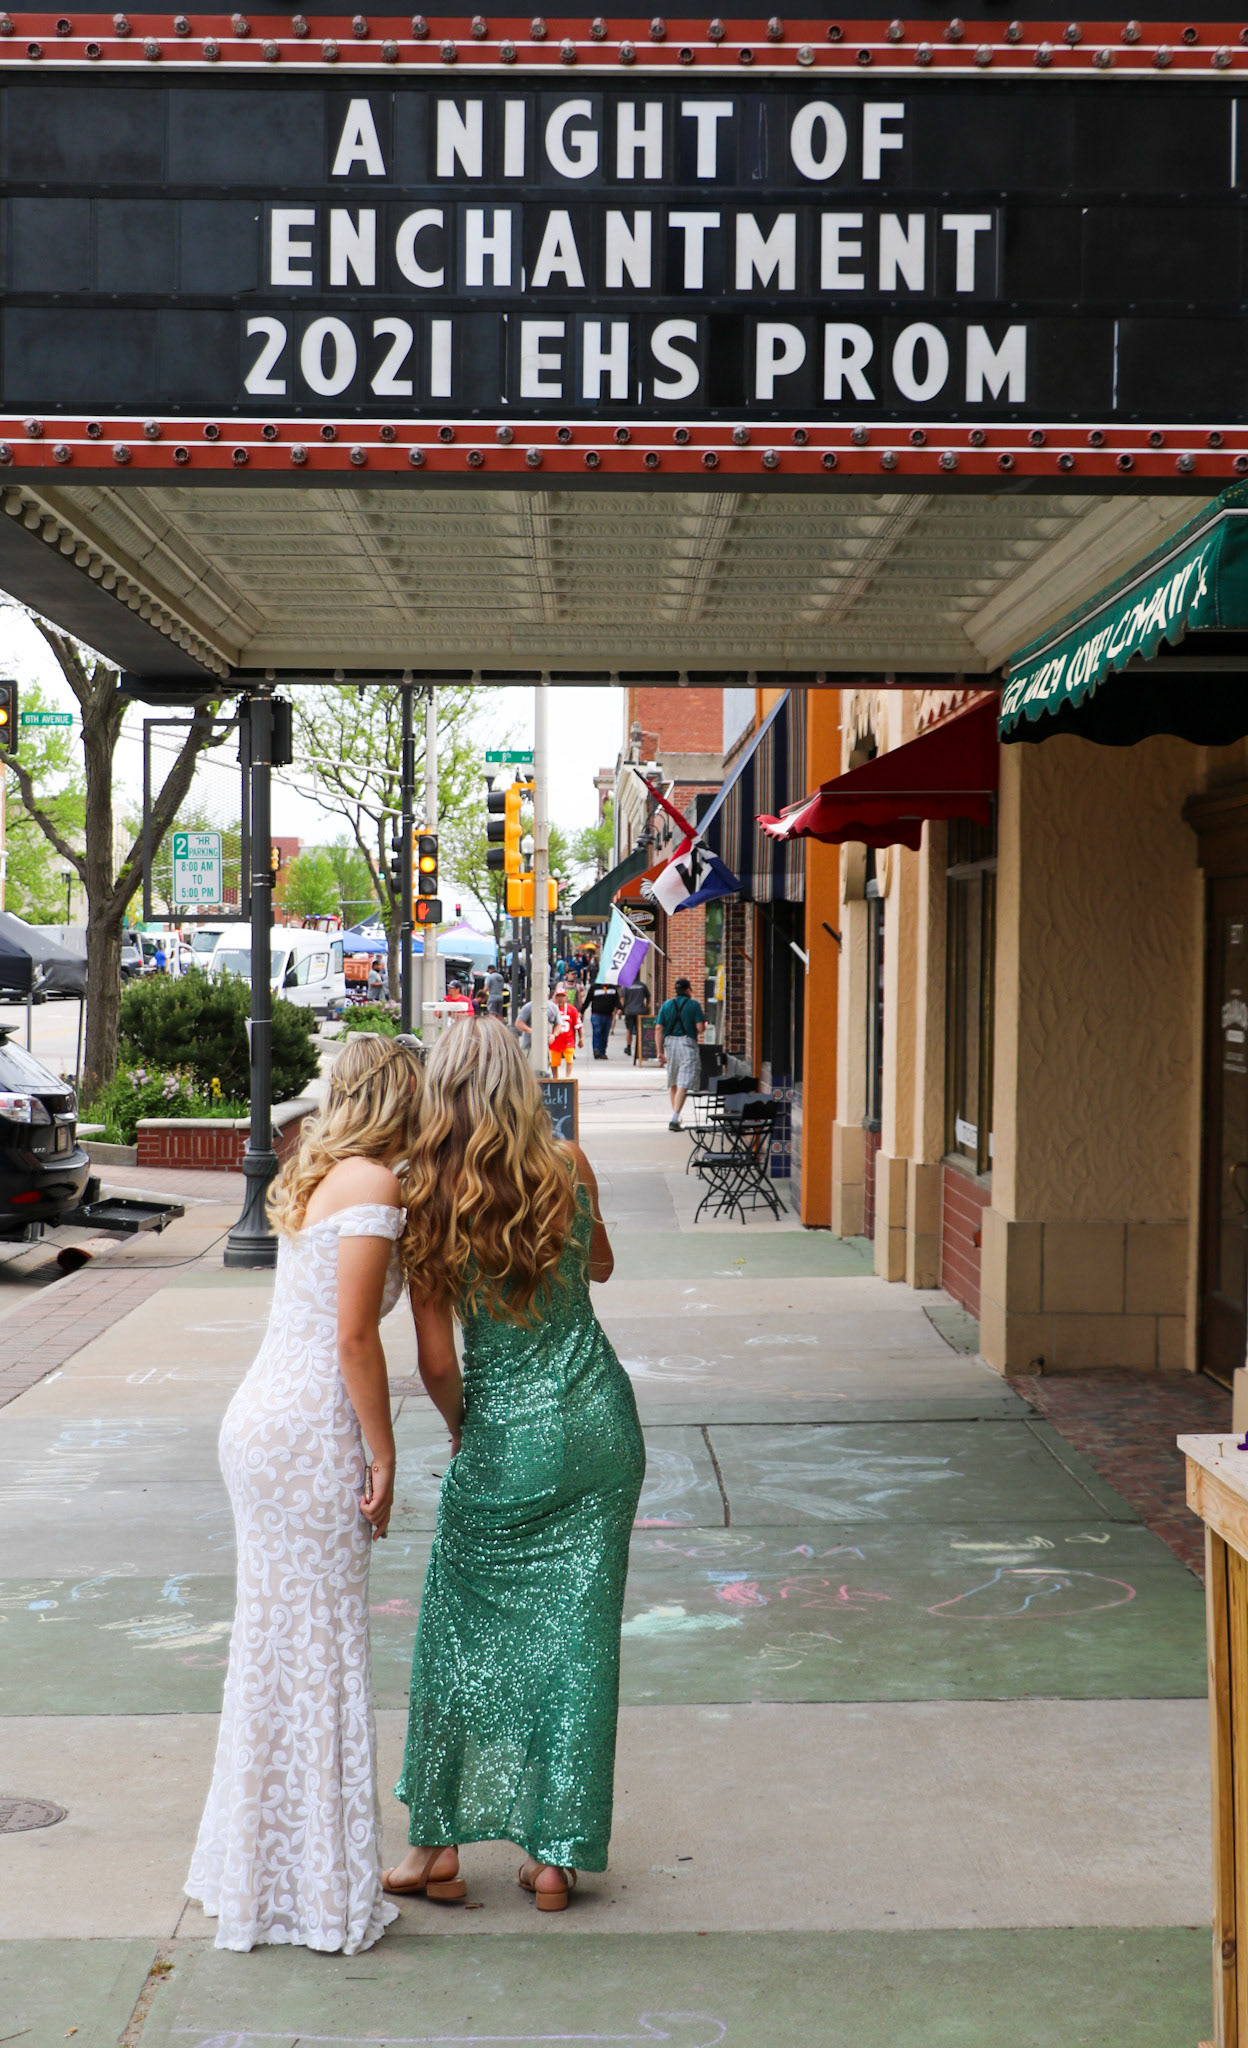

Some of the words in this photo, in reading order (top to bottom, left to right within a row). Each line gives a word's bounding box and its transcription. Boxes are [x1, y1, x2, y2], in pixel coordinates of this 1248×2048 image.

[331, 98, 386, 176] A
[436, 99, 733, 179] NIGHT
[790, 100, 904, 180] OF
[269, 208, 992, 292] ENCHANTMENT
[243, 315, 453, 397] 2021
[519, 319, 700, 399] EHS
[755, 321, 1027, 403] PROM
[25, 714, 39, 724] 8TH
[42, 714, 70, 725] AVENUE
[176, 837, 187, 856] 2
[198, 836, 210, 845] HR
[188, 847, 219, 857] PARKING
[181, 861, 198, 872] 8:00
[201, 861, 214, 871] AM
[192, 874, 203, 885] TO
[181, 887, 198, 898] 5:00
[202, 887, 214, 898] PM
